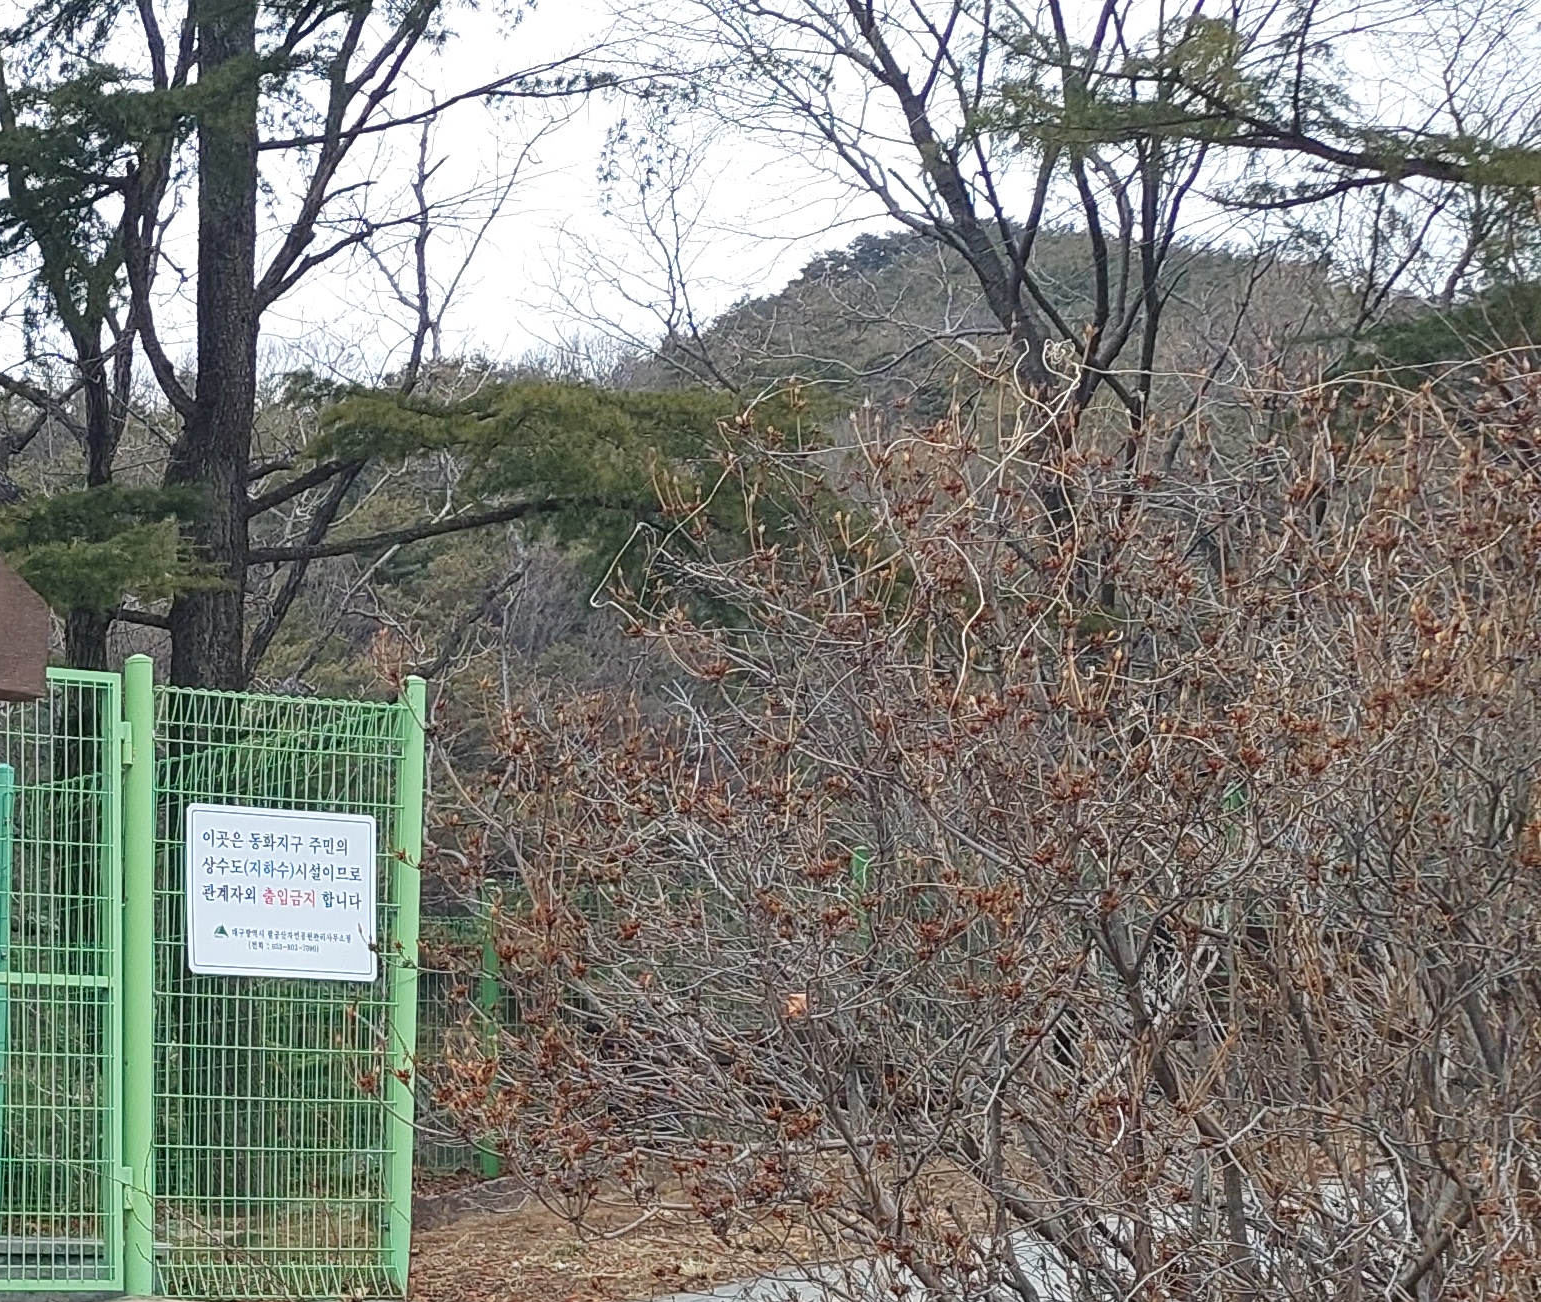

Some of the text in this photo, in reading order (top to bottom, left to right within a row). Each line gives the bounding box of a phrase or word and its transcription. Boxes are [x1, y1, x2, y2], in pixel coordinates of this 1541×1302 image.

[202, 829, 348, 856] 이곳은 동화지구 주민의
[202, 856, 363, 882] 상수도(지하수)시설이므로
[202, 884, 362, 911] 관계자외 출입금지 합니다
